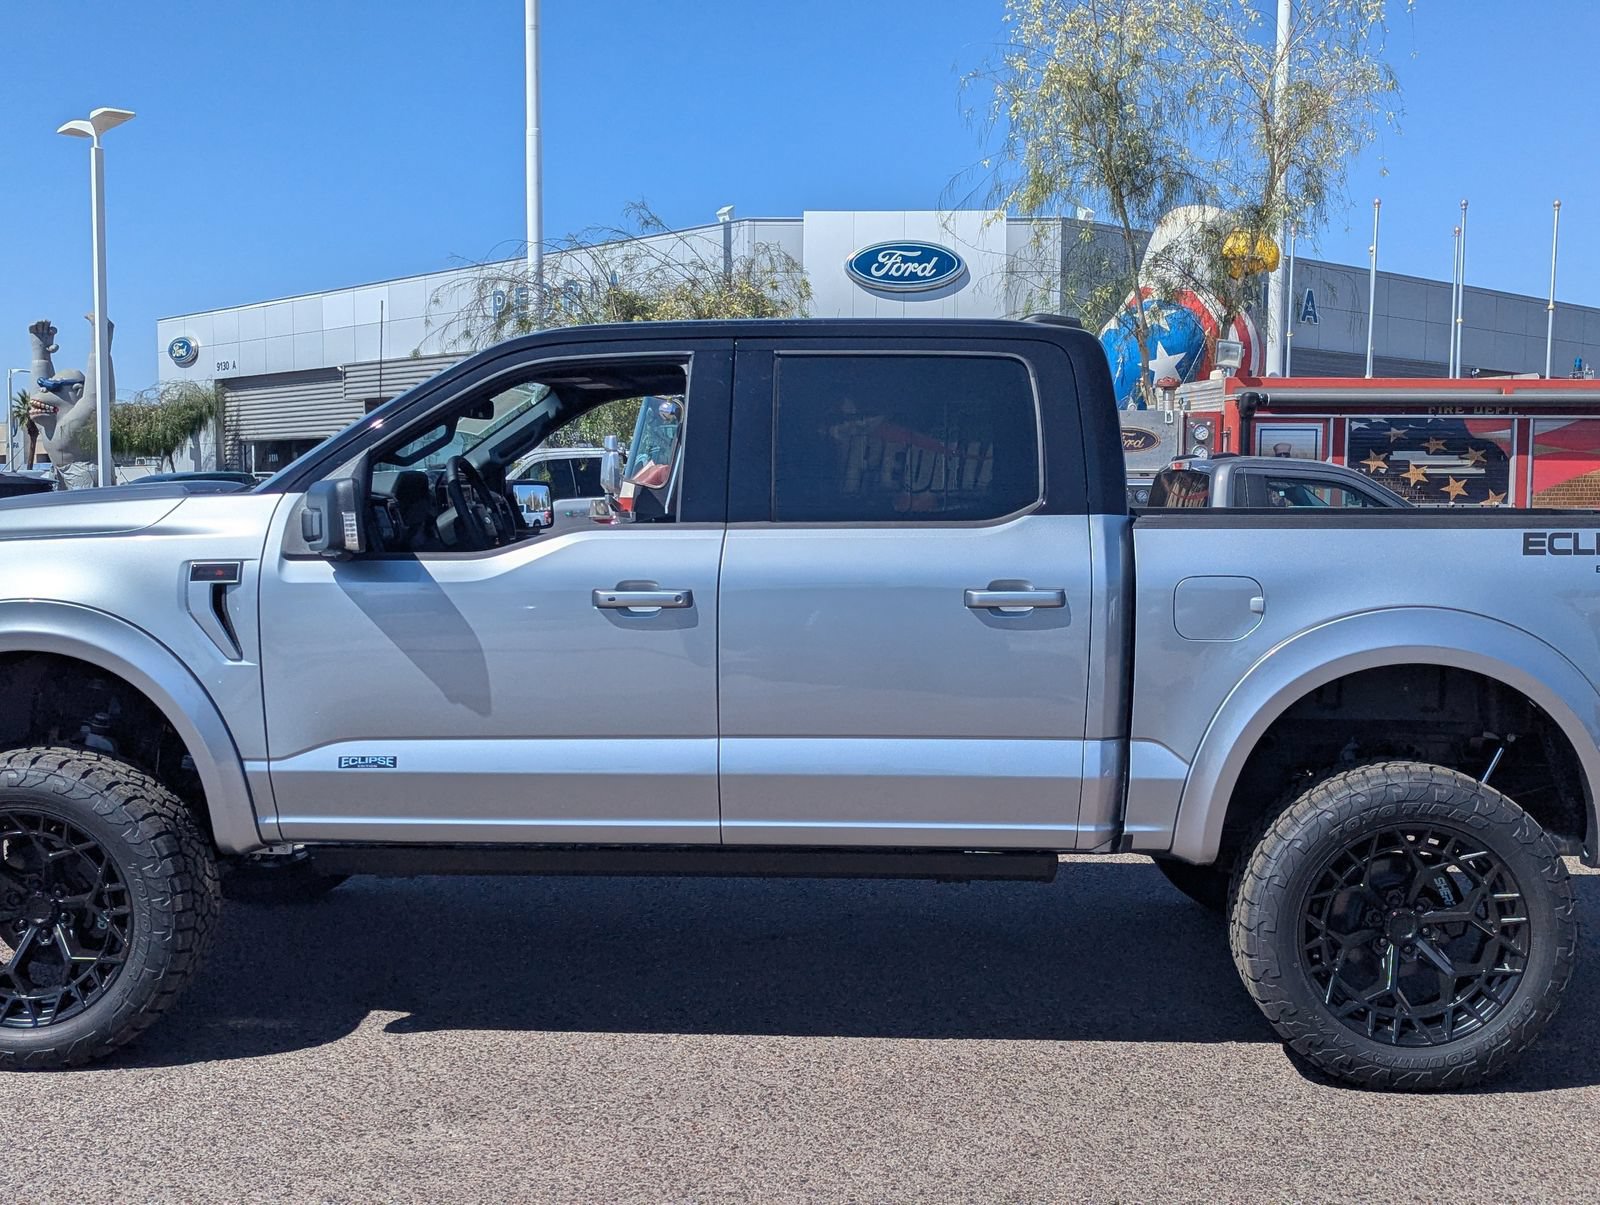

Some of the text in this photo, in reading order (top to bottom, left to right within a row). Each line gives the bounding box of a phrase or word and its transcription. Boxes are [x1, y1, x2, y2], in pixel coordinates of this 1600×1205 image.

[871, 250, 939, 277] Ford
[216, 361, 230, 371] 9130
[341, 756, 394, 768] ECLIPSE
